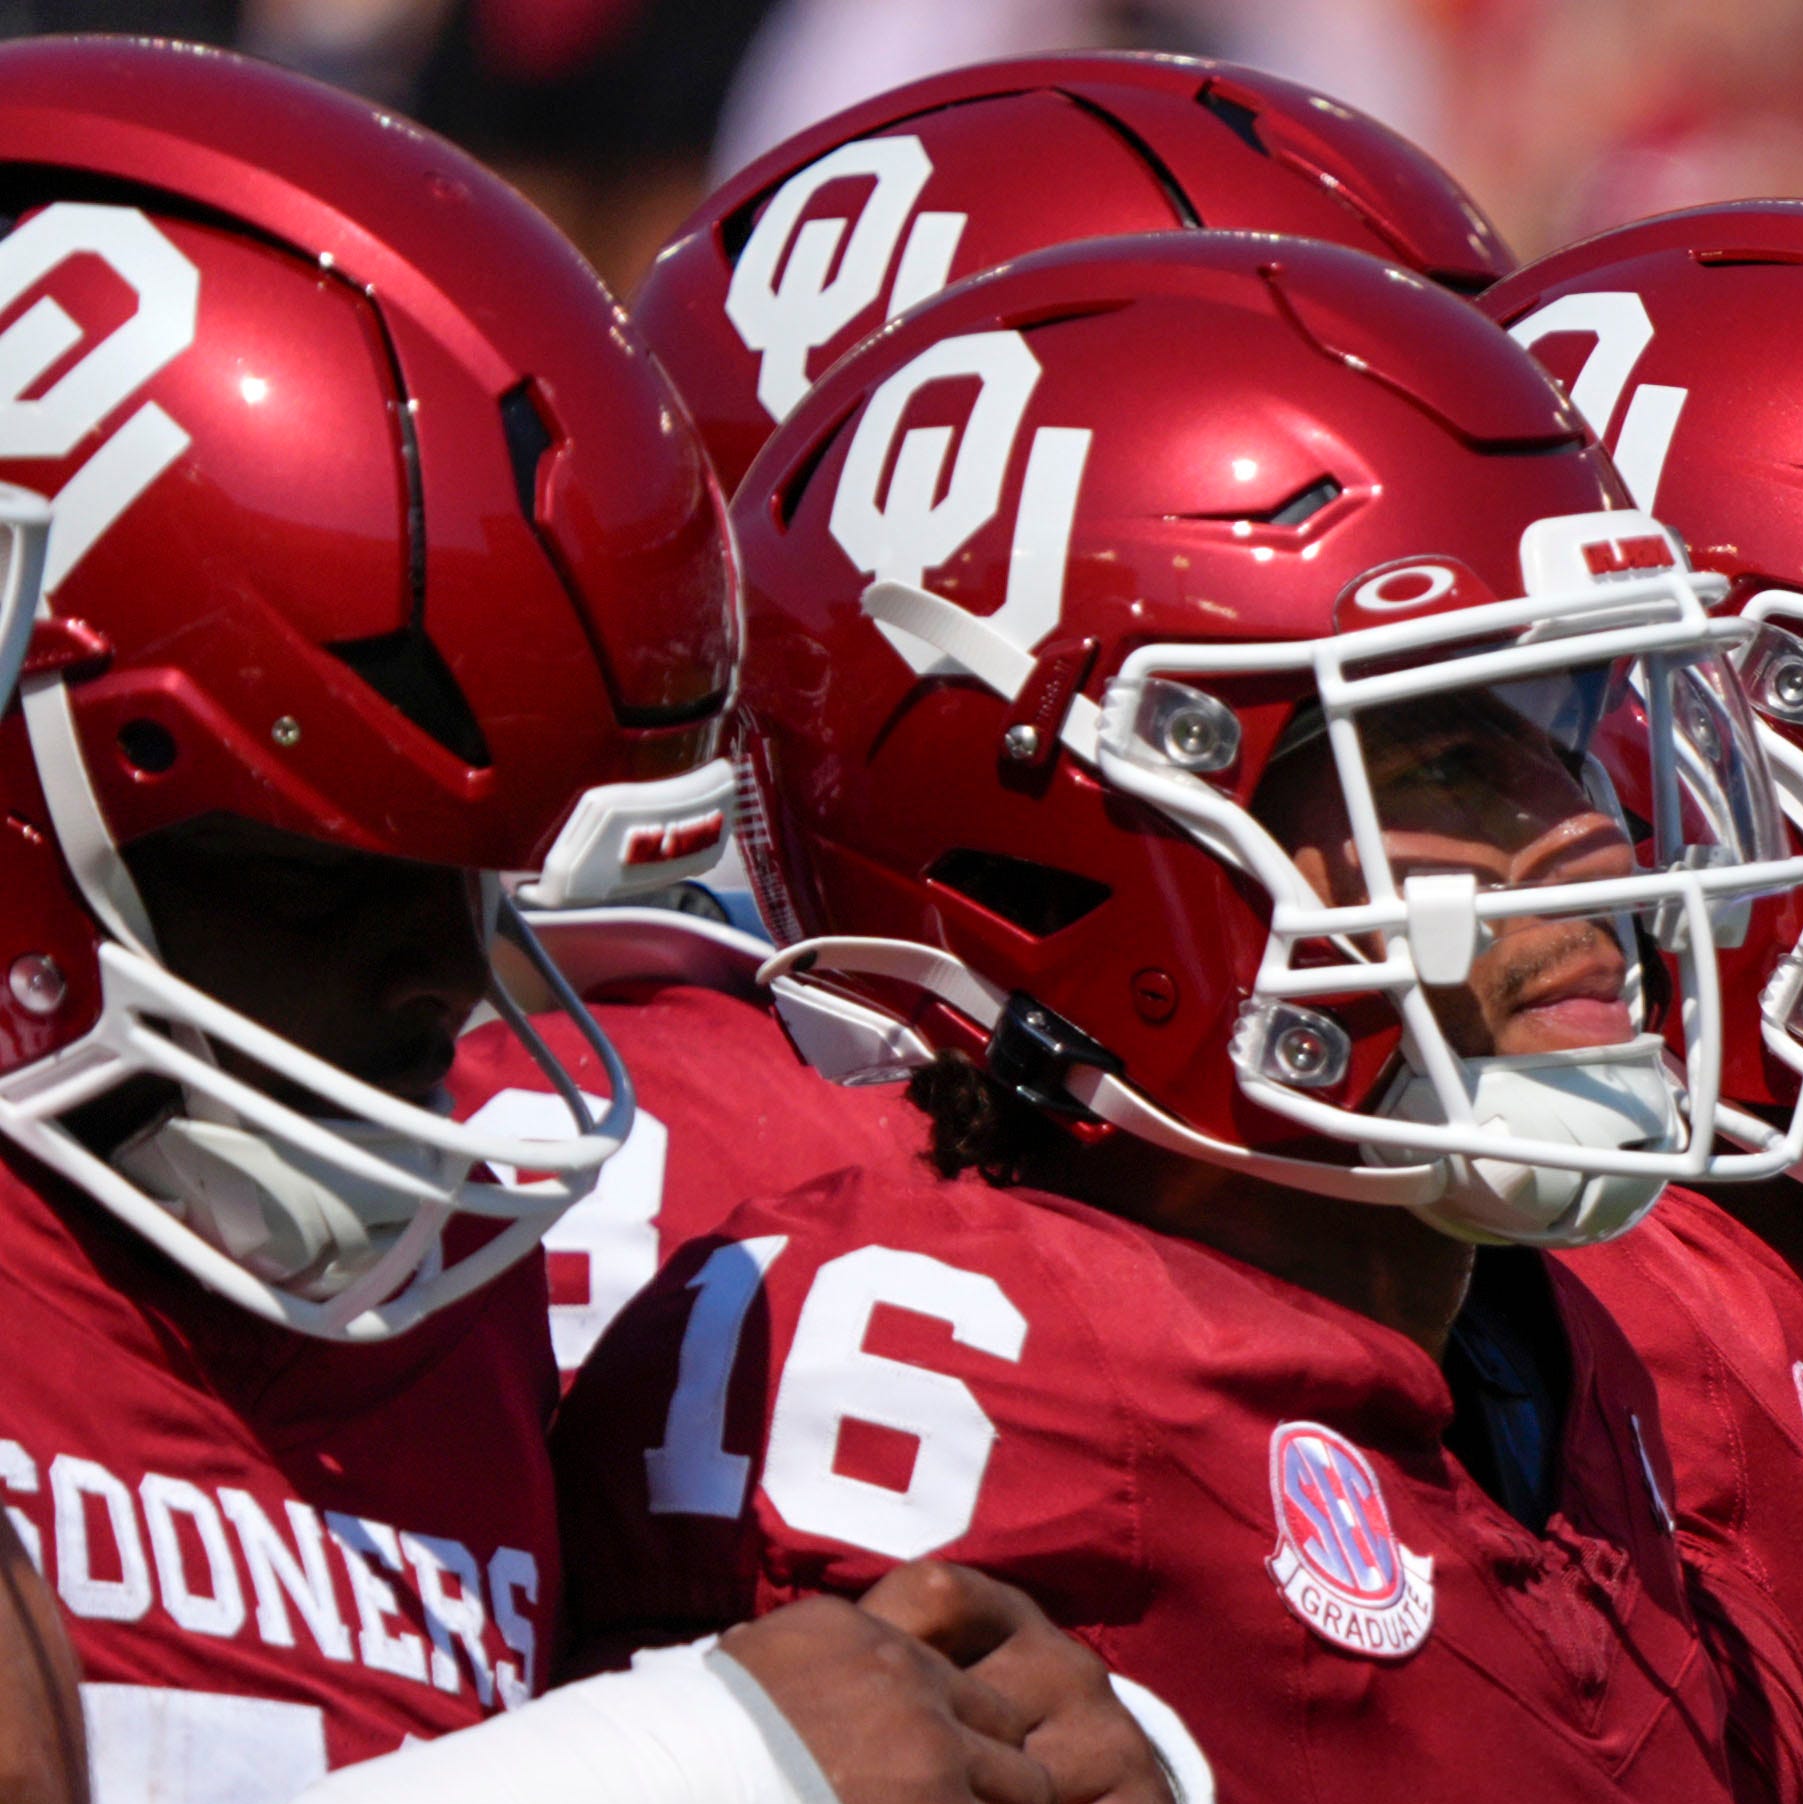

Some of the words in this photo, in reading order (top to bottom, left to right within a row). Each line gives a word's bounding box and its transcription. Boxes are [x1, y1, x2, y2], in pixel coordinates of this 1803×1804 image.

[829, 330, 1092, 675] OU
[644, 1234, 1029, 1560] 16
[1283, 1436, 1395, 1592] SEC
[1300, 1585, 1429, 1650] GRADUATE
